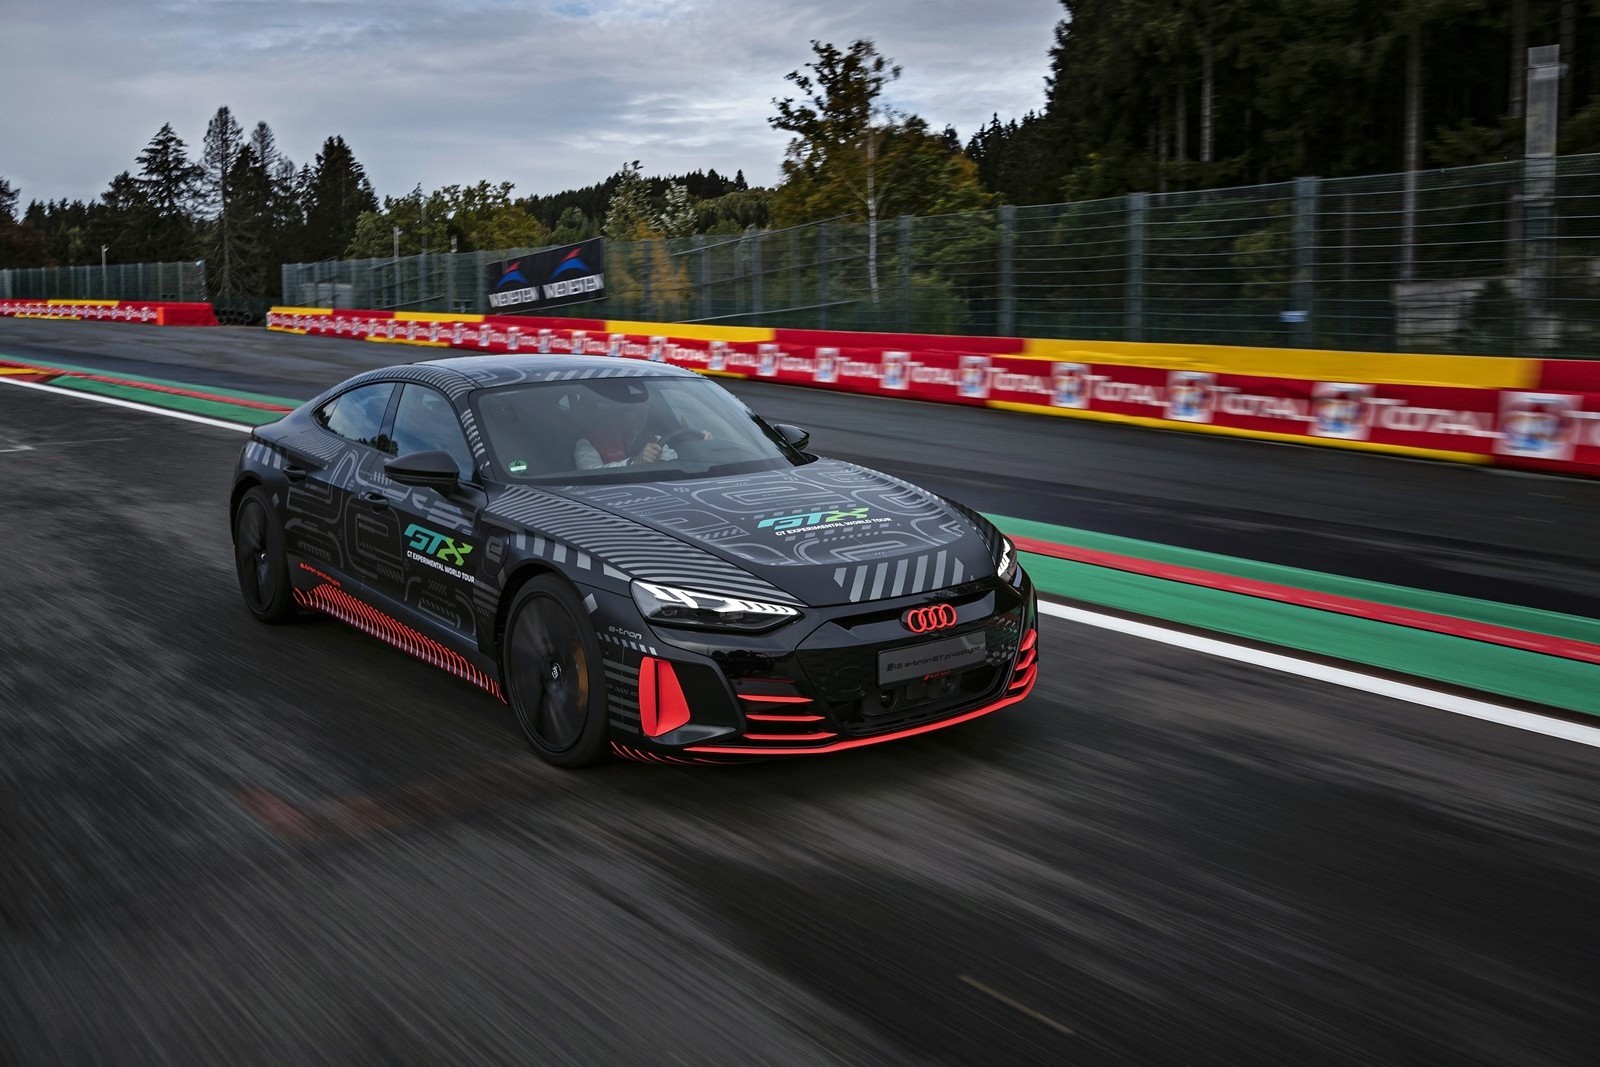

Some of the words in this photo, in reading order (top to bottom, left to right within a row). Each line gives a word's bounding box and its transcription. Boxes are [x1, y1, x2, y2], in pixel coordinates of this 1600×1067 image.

[786, 523, 845, 535] EXPERIMENTAL
[843, 518, 872, 527] WORLD
[412, 553, 444, 572] EXPERIMENTAL
[444, 566, 462, 578] WORLD
[461, 572, 475, 583] TOUR
[608, 626, 642, 640] e-tron
[904, 657, 932, 668] e-tron
[932, 654, 945, 662] GT
[945, 645, 980, 661] prototype
